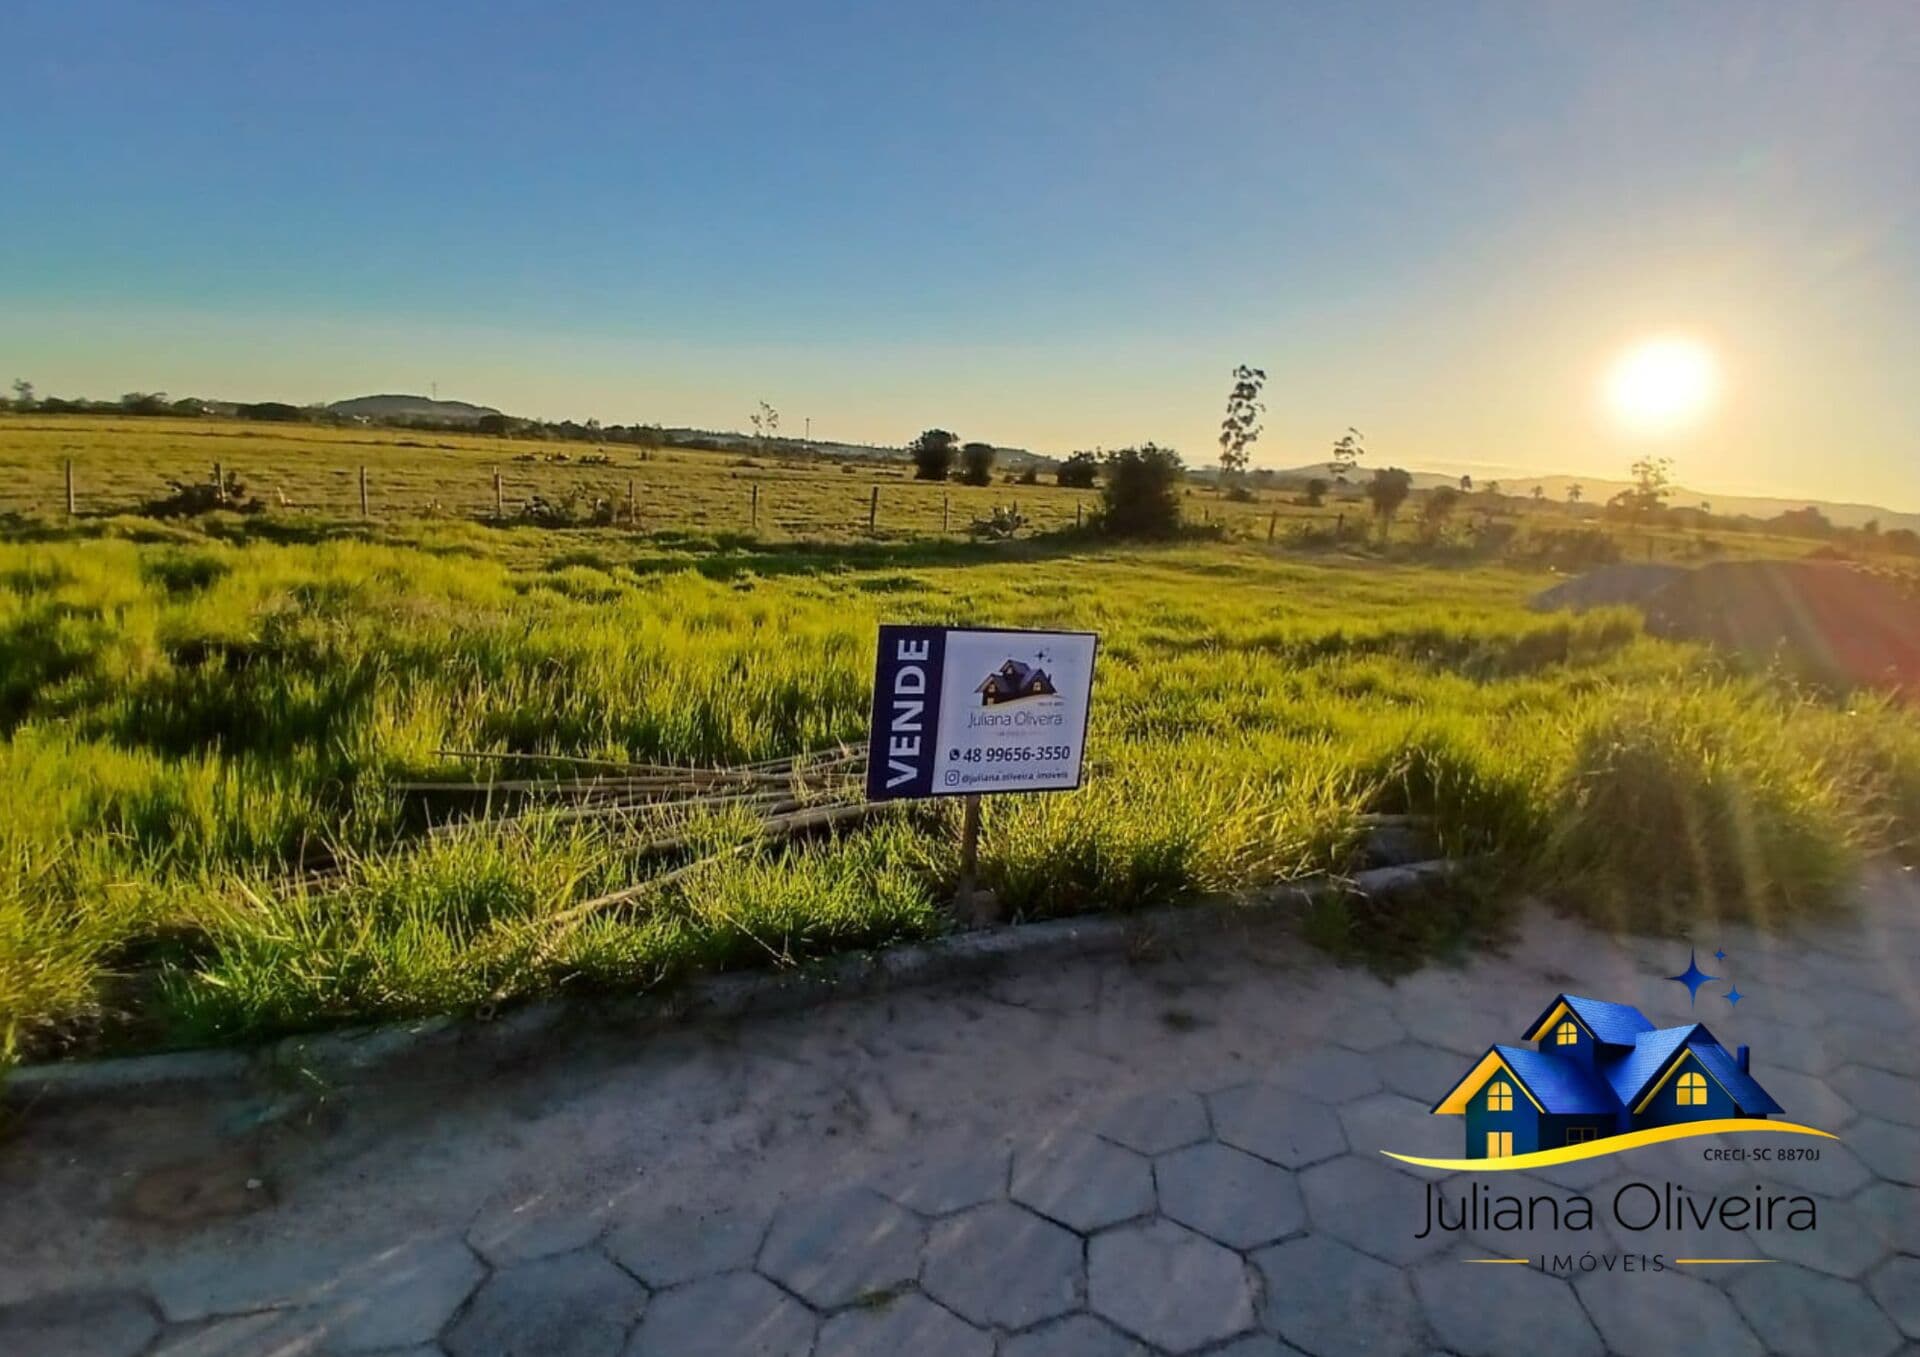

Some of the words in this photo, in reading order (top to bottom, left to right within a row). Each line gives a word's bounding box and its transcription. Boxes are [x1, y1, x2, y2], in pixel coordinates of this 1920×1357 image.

[886, 639, 929, 789] VENDE
[968, 712, 1011, 729] Juliana
[1014, 711, 1063, 726] Oliveira
[963, 748, 981, 763] 48
[986, 745, 1071, 763] 99656-3550
